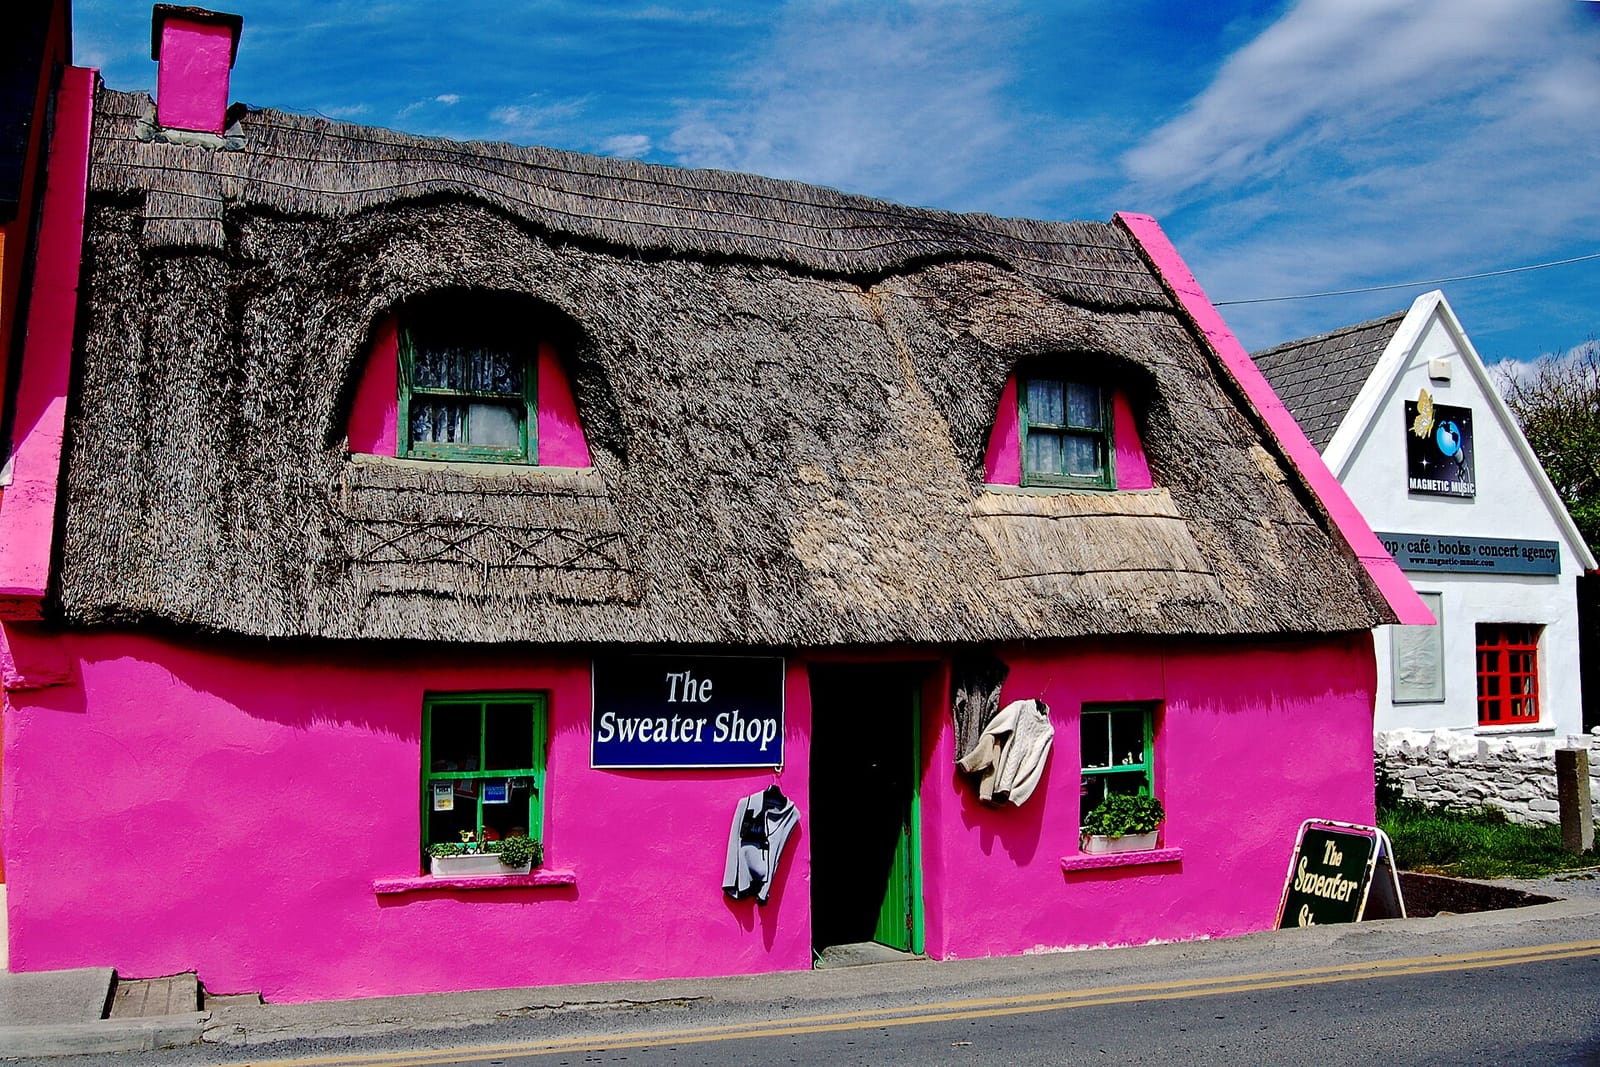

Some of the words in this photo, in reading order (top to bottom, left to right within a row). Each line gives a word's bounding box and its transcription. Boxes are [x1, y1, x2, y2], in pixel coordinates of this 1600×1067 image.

[1409, 477, 1449, 492] MAGNETIC
[1451, 480, 1475, 494] MUSIC
[1384, 540, 1399, 556] op
[1407, 538, 1431, 554] café
[1437, 539, 1471, 556] books
[1478, 542, 1520, 559] concert
[1521, 547, 1557, 563] agency
[666, 670, 713, 703] The
[597, 711, 707, 743] Sweater
[713, 709, 777, 751] Shop
[1322, 839, 1343, 867] The
[1294, 855, 1358, 902] Sweater
